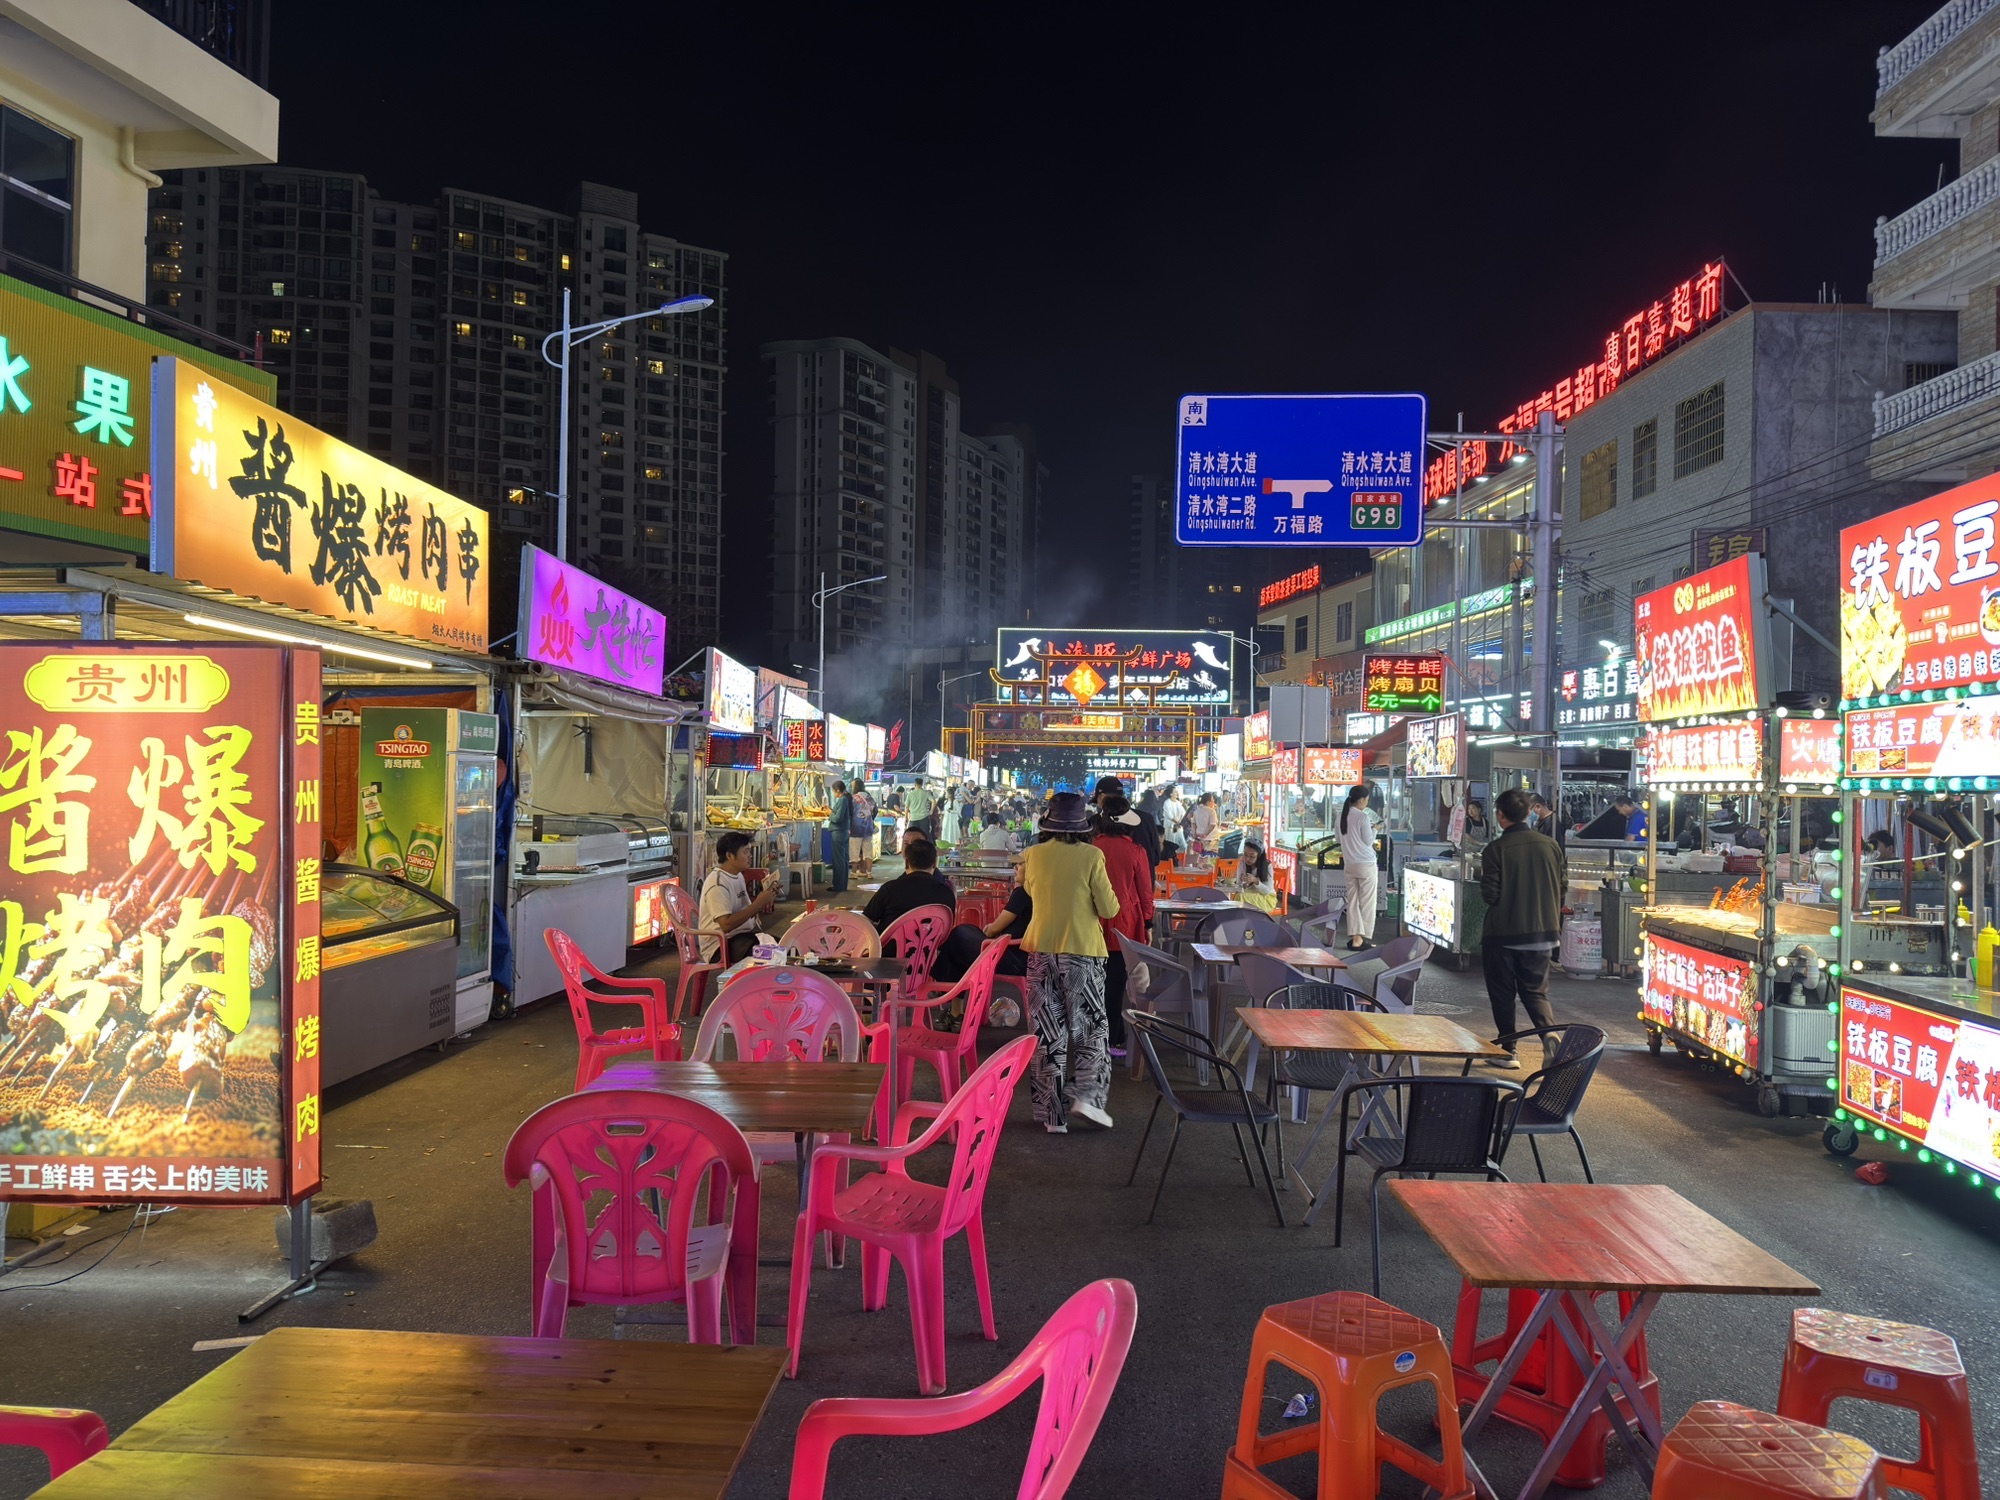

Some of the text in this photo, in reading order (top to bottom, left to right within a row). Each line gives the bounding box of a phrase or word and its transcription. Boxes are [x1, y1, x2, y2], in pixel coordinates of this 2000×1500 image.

[1606, 263, 1721, 378] 惠百嘉超市
[1187, 401, 1203, 415] 南
[1184, 416, 1191, 425] S
[1189, 451, 1258, 475] 清水湾大道
[1341, 451, 1413, 475] 清水湾大道
[1423, 431, 1488, 505] 球俱乐部
[1188, 473, 1258, 491] Qingshuiwan Ave.
[1341, 473, 1413, 490] Qingshuiwan Ave.
[1188, 494, 1257, 518] 清水湾二路
[1355, 494, 1398, 503] 国家高速
[1187, 517, 1243, 532] Qingshuiwaner
[1273, 515, 1324, 534] 万福路
[1355, 506, 1396, 526] G98
[1850, 500, 2000, 610] 铁板豆
[387, 583, 448, 615] ROAST MEAT
[1652, 614, 1743, 690] 铁板鱿鱼
[1369, 659, 1441, 675] 烤生蚝
[66, 663, 188, 703] 贵州
[1072, 669, 1096, 695] 福
[1368, 677, 1440, 693] 烤扇贝
[1583, 660, 1639, 699] 惠百嘉
[1368, 694, 1440, 711] 2元一个
[1784, 722, 1813, 733] 王记
[1851, 715, 1943, 747] 铁板豆腐
[379, 743, 427, 754] TSINGTAO
[787, 722, 804, 759] 馅饼
[808, 723, 824, 759] 水饺
[384, 759, 424, 769] 青岛啤酒
[0, 723, 265, 876] 酱爆
[407, 855, 435, 868] TSINGTAO
[295, 701, 320, 1144] 贵州酱爆烤肉
[0, 892, 253, 1035] 烤肉
[1846, 1020, 1939, 1089] 铁板豆腐
[102, 1163, 269, 1193] 舌尖上的美味
